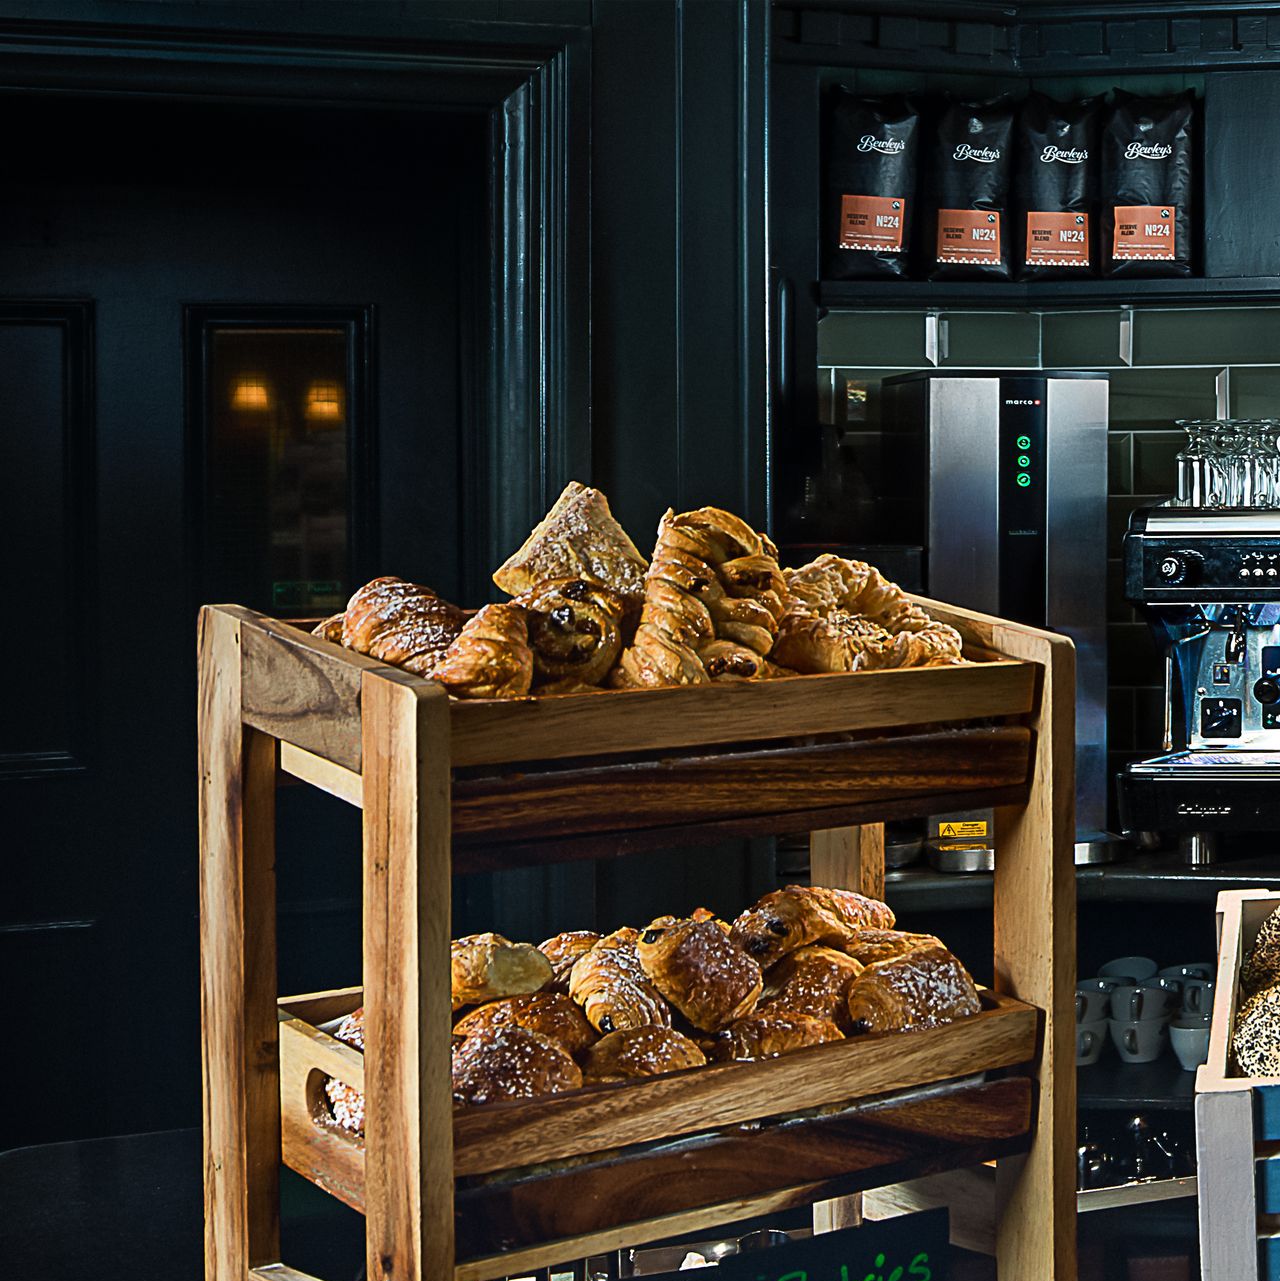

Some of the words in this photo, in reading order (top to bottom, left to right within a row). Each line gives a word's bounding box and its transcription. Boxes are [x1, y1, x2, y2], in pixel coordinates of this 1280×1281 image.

[857, 134, 905, 155] Bewley's
[953, 143, 1000, 163] Bewley's
[1124, 141, 1172, 160] Bewley's
[1040, 145, 1089, 164] Bewley's
